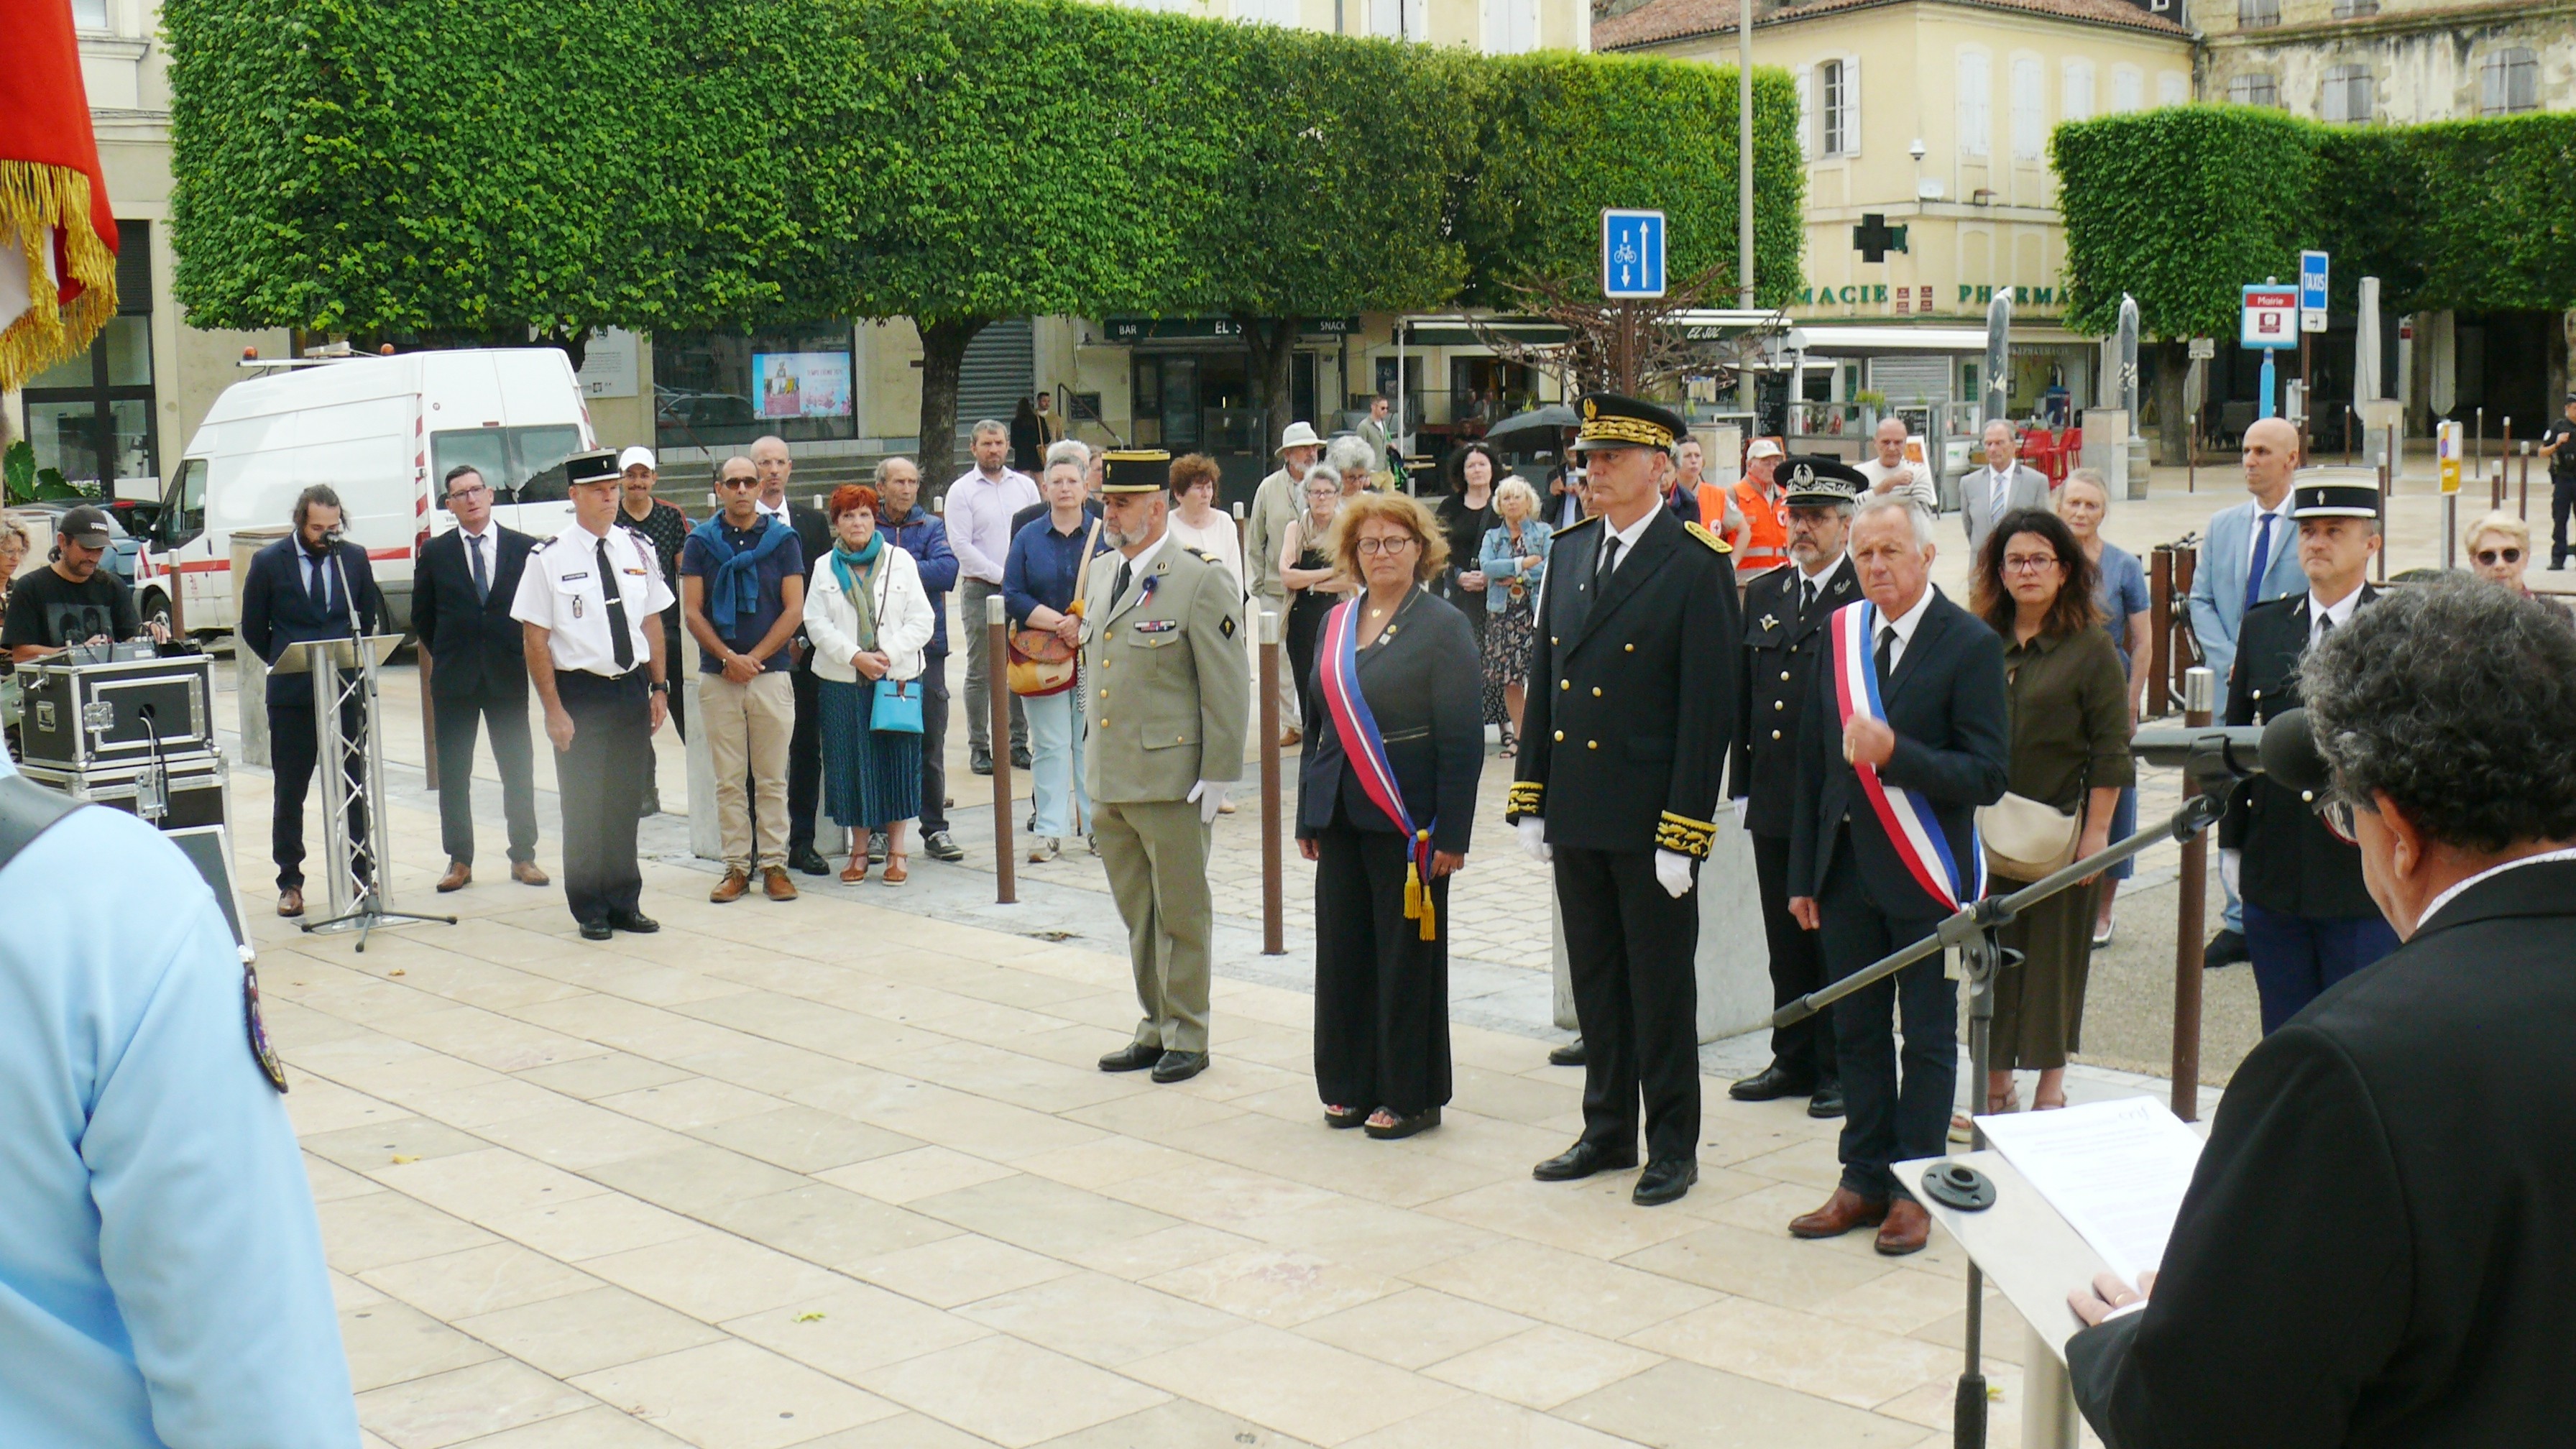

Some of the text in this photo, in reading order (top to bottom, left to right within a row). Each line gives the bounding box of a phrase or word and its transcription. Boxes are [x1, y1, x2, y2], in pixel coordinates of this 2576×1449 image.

[2304, 273, 2324, 292] TAXIS
[1959, 285, 2070, 305] PHRMA
[2257, 295, 2284, 306] Mairie
[1118, 324, 1137, 336] BAR
[1215, 321, 1229, 334] EL
[1320, 321, 1347, 332] SNACK
[1687, 326, 1722, 339] EL SOL
